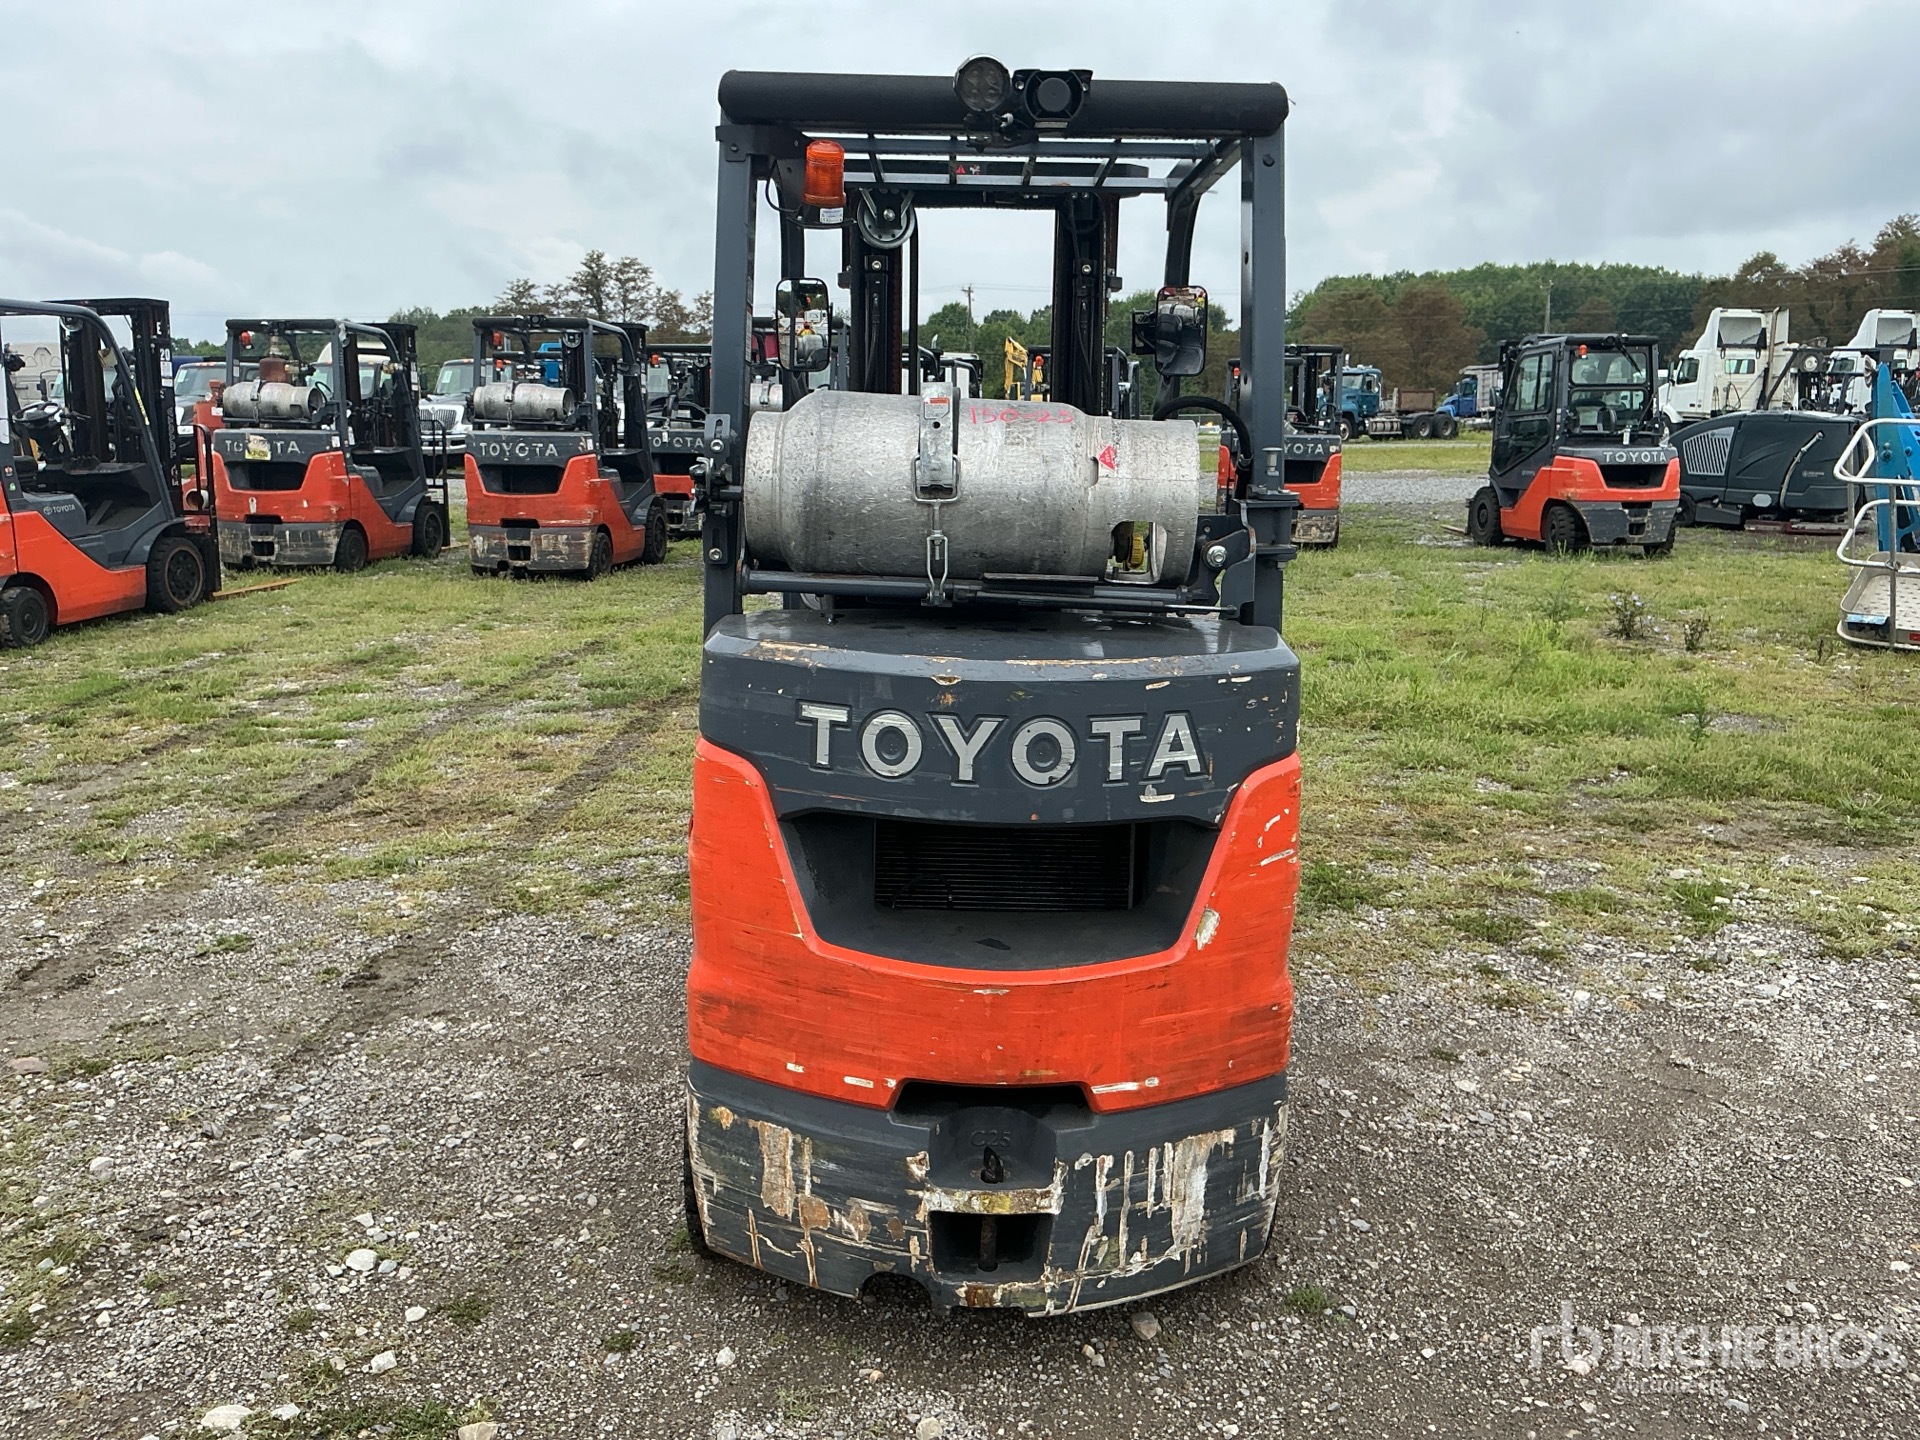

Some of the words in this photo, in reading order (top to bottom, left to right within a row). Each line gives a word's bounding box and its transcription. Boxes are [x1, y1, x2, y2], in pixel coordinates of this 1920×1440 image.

[159, 348, 171, 361] 20
[968, 405, 1074, 425] 150-25
[480, 443, 559, 456] TOYOTA
[1284, 443, 1325, 454] YOTA
[1604, 451, 1667, 463] TOYOTA
[52, 504, 76, 513] TOYOTA
[799, 702, 1207, 786] TOYOTA
[970, 1129, 1011, 1147] C25
